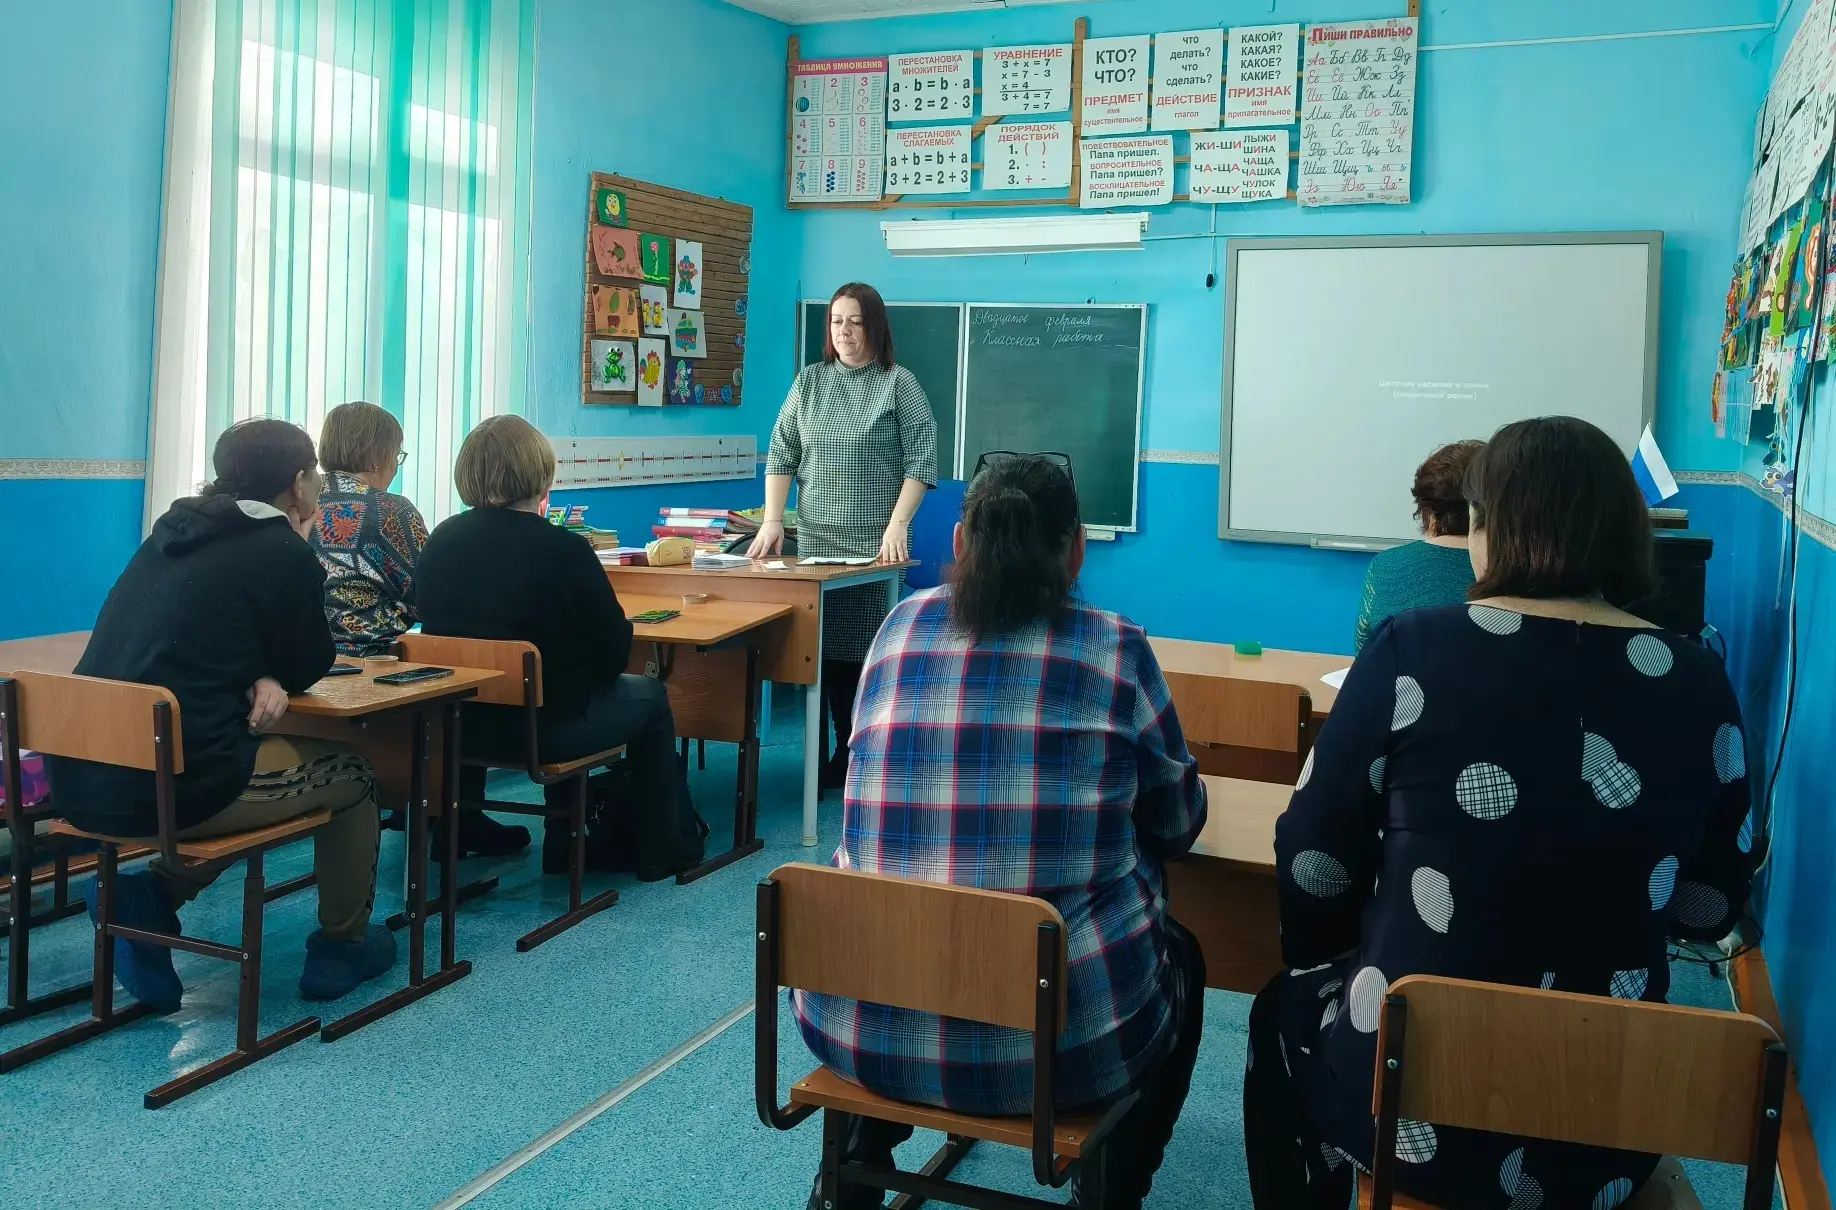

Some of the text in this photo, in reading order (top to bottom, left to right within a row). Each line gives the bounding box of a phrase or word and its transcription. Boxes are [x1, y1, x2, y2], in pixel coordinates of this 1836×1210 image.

[1241, 31, 1283, 43] КАКОЙ?
[1350, 27, 1413, 39] ПРАВИЛЬНО
[1183, 36, 1199, 44] что
[994, 48, 1062, 60] УРАВНЕНИЕ
[1170, 47, 1211, 60] делать?
[1241, 44, 1282, 56] КАКАЯ?
[898, 54, 962, 66] ПЕРЕСТАНОВКА
[1096, 48, 1136, 64] КТО?
[798, 60, 882, 72] ТАБЛИЦА УМНОЖЕНИЯ
[1240, 58, 1282, 68] КАКОЕ?
[902, 63, 958, 75] МНОЖИТЕЛЕЙ
[1022, 70, 1028, 78] 7
[1095, 68, 1136, 83] ЧТО?
[1166, 74, 1212, 86] сделать?
[1241, 70, 1281, 81] КАКИЕ?
[802, 80, 807, 88] 1
[831, 78, 838, 88] 2
[861, 77, 868, 86] 3
[914, 78, 922, 91] b
[941, 77, 948, 90] b
[1002, 93, 1008, 101] 3
[1023, 92, 1029, 100] 4
[1228, 85, 1291, 98] ПРИЗНАК
[892, 99, 900, 112] 3
[915, 98, 922, 111] 2
[941, 96, 948, 110] 2
[963, 95, 970, 108] 3
[1085, 93, 1143, 106] ПРЕДМЕТ
[1156, 94, 1217, 106] ДЕЙСТВИЕ
[1228, 109, 1291, 119] прилагательное
[800, 120, 806, 128] 4
[829, 118, 835, 127] 5
[859, 117, 866, 126] 6
[1084, 116, 1142, 127] существительное
[1001, 124, 1056, 132] ПОРЯДОК
[897, 130, 962, 140] ПЕРЕСТАНОВКА
[998, 132, 1059, 143] ДЕЙСТВИЙ
[1244, 135, 1276, 143] ЛЫЖИ
[904, 138, 954, 147] СЛАГАЕМЫХ
[1083, 139, 1168, 150] ПОВЕСТВОВАТЕЛЬНОЕ
[1195, 141, 1241, 150] ЖИ-ШИ
[1009, 144, 1018, 154] 1.
[1090, 149, 1159, 159] Папа пришел.
[901, 154, 908, 164] +
[913, 152, 920, 165] b
[937, 151, 944, 164] b
[949, 152, 956, 162] +
[1244, 157, 1274, 165] ЧАЩА
[799, 160, 805, 169] 7
[828, 160, 835, 169] 8
[859, 159, 865, 168] 9
[1009, 159, 1020, 170] 2.
[1090, 160, 1161, 170] ВОПРОСИТЕЛЬНОЕ
[1195, 164, 1240, 172] ЧА-ЩА
[1090, 167, 1163, 179] Папа пришел?
[1242, 168, 1281, 176] ЧАШКА
[890, 172, 897, 185] 3
[902, 174, 909, 184] +
[914, 172, 921, 184] 2
[938, 171, 944, 184] 2
[949, 172, 956, 182] +
[961, 170, 968, 183] 3
[1008, 175, 1019, 184] 3.
[1089, 180, 1165, 190] ВОСКЛИЦАТЕЛЬНОЕ
[1193, 186, 1239, 194] ЧУ-ЩУ
[1117, 188, 1159, 199] пришел!
[972, 309, 1029, 328] Двадцатое
[983, 329, 1041, 346] Классная
